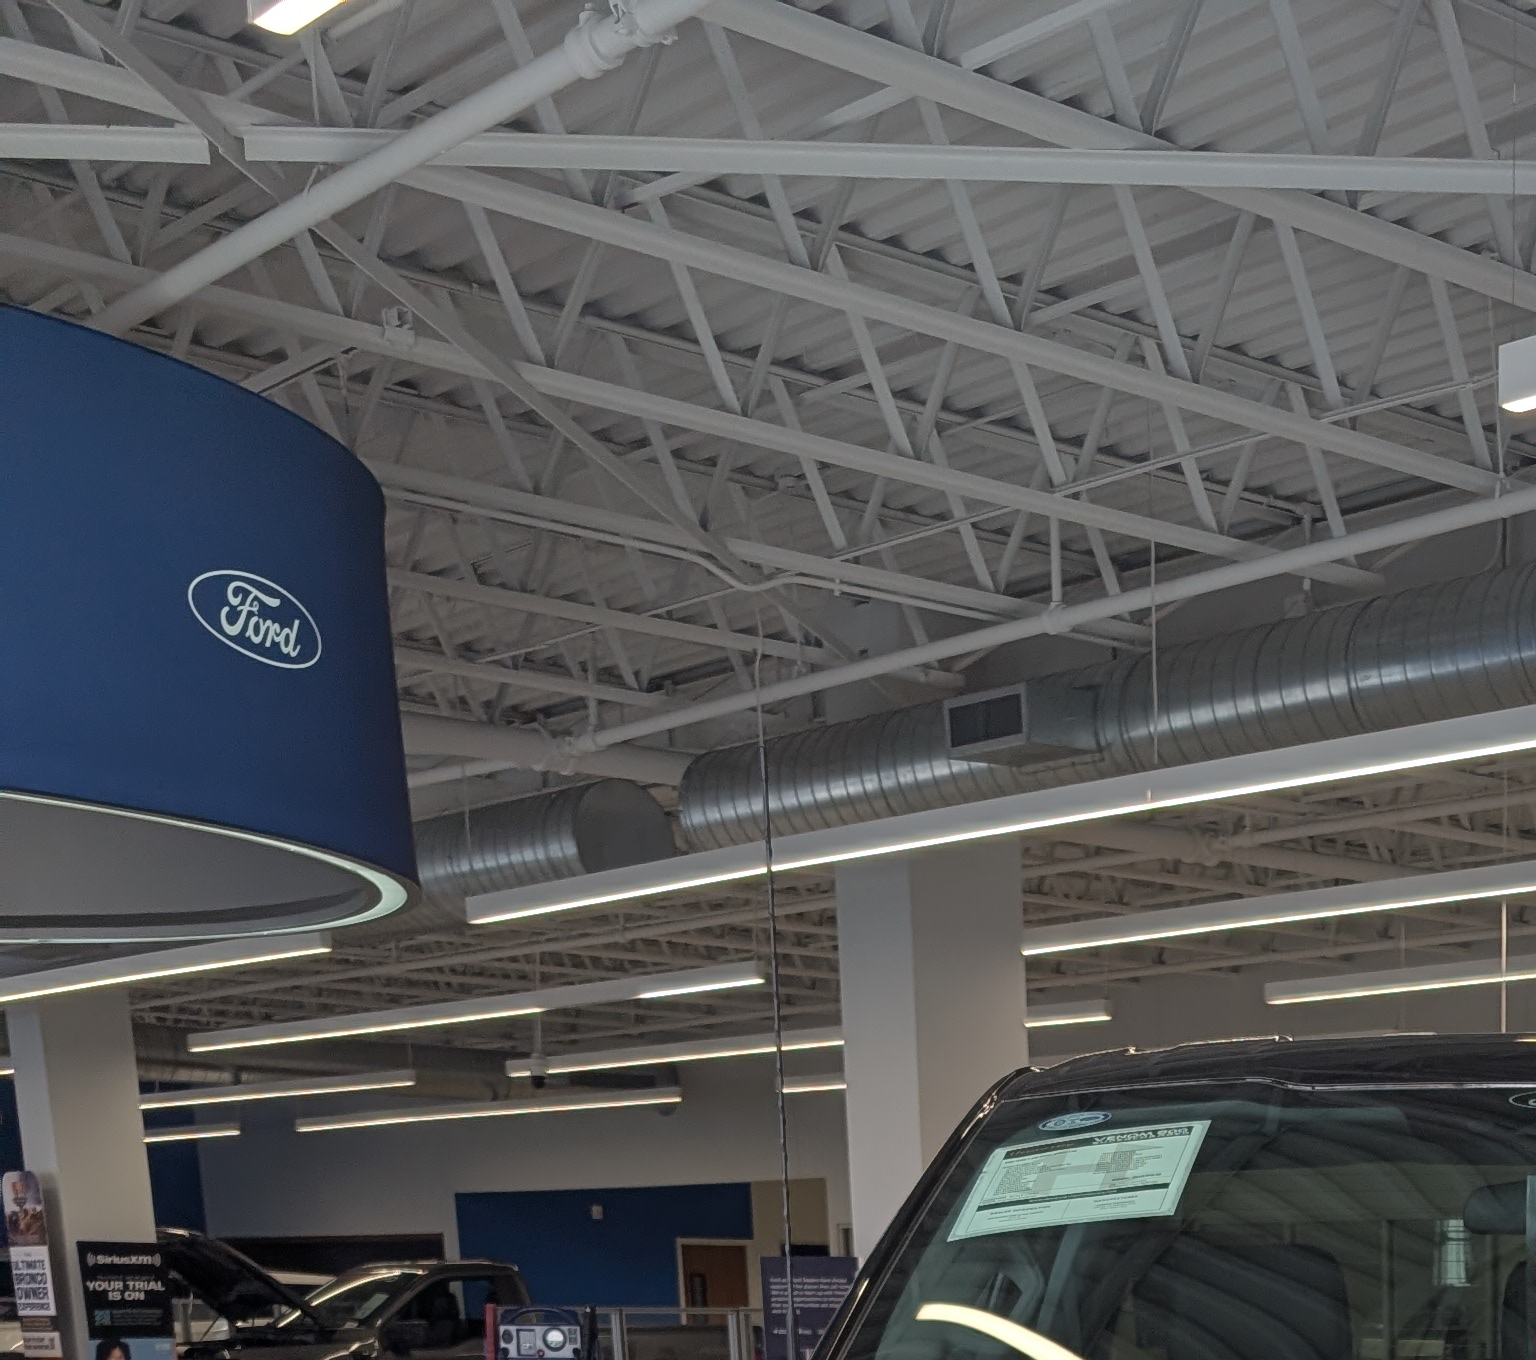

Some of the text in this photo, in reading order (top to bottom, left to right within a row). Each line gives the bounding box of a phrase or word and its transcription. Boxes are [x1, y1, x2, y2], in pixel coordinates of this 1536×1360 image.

[220, 581, 301, 657] Ford
[86, 1281, 166, 1291] YOUR TRIAL
[108, 1291, 145, 1300] IS ON
